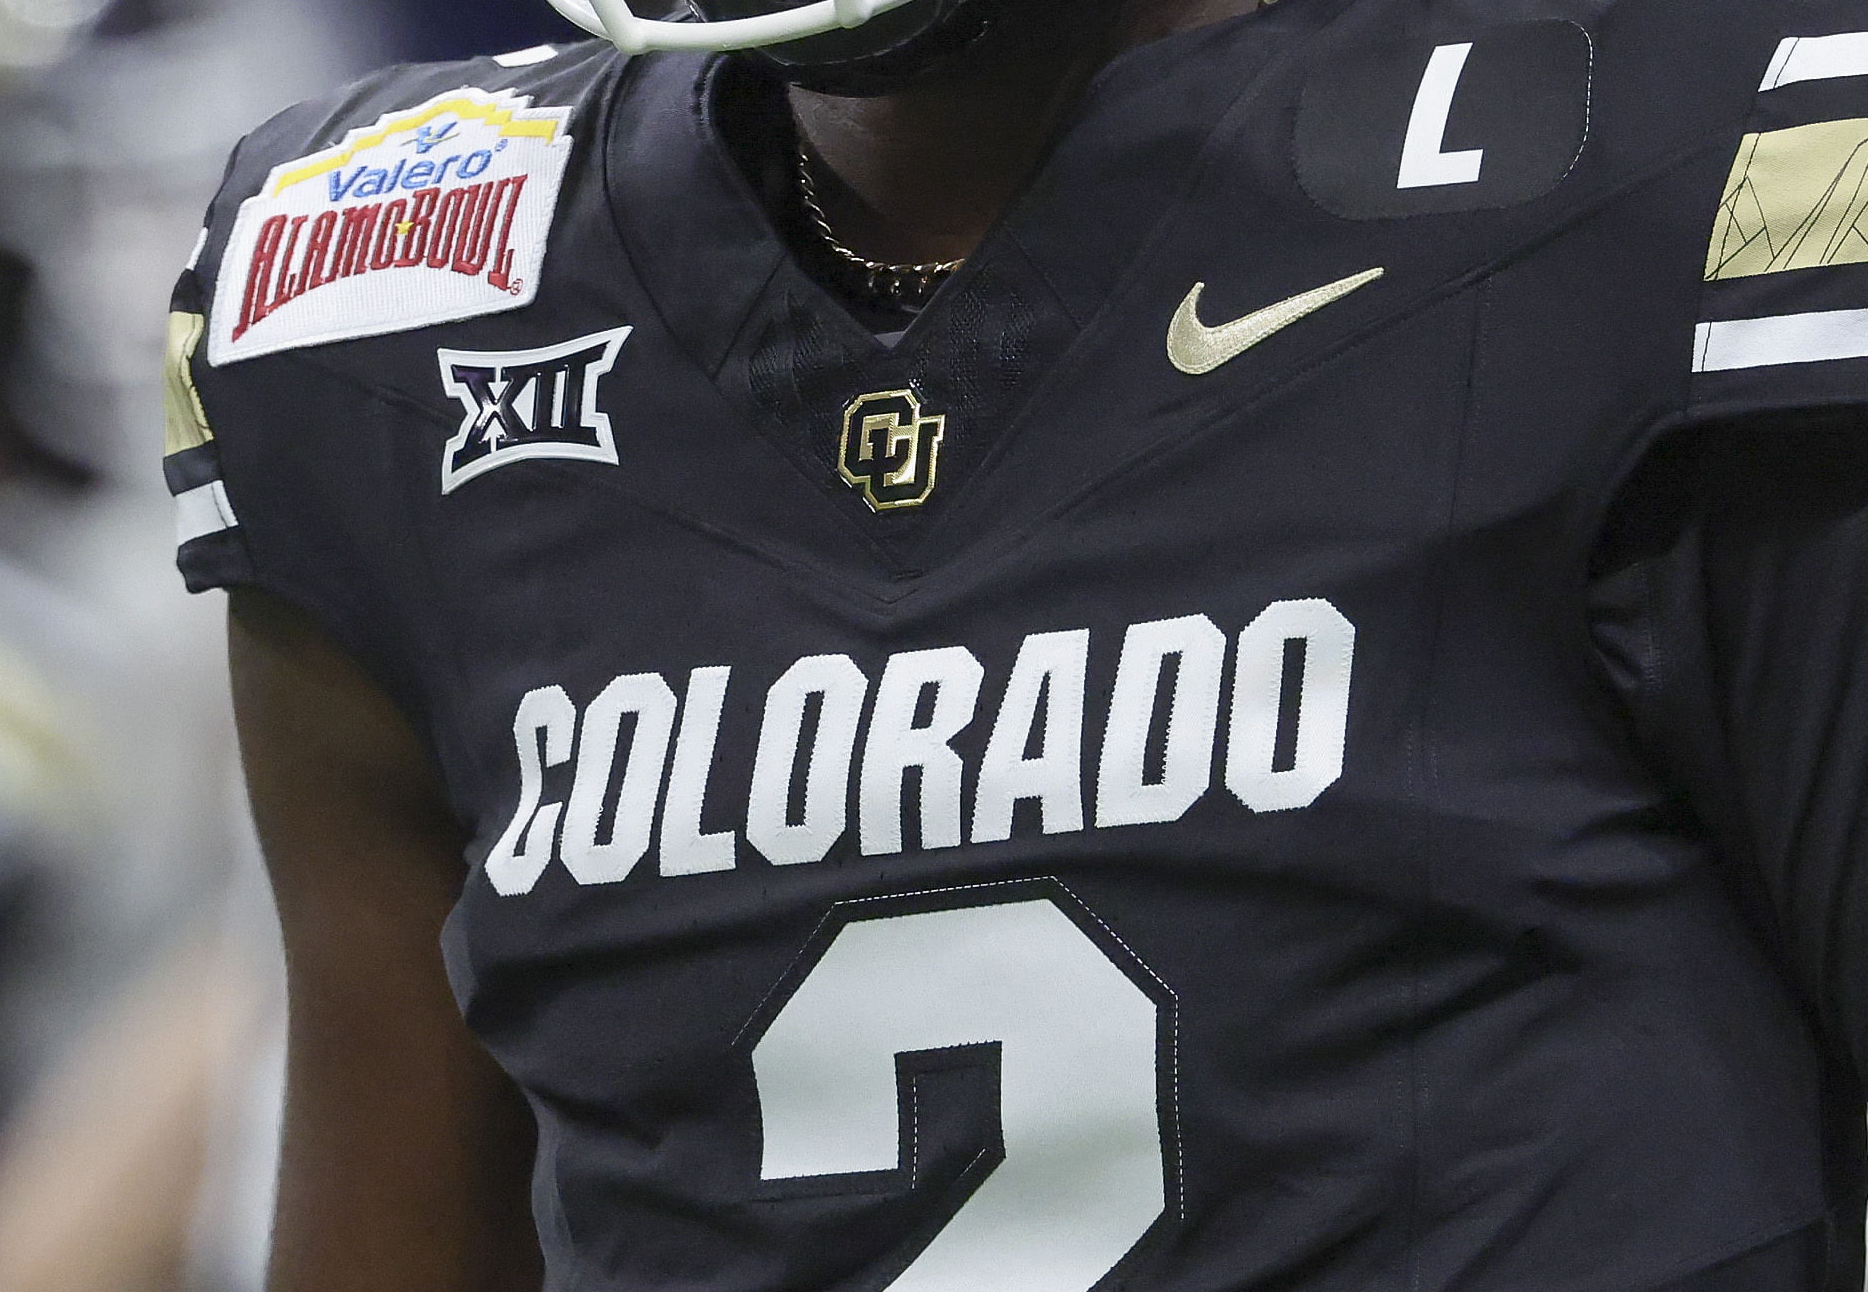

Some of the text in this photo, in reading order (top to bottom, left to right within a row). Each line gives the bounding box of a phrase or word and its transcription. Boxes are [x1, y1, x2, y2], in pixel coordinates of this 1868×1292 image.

[328, 149, 492, 202] Valero
[1397, 42, 1484, 189] L
[442, 335, 625, 485] XII
[836, 388, 946, 511] CU
[485, 597, 1356, 897] COLORADO
